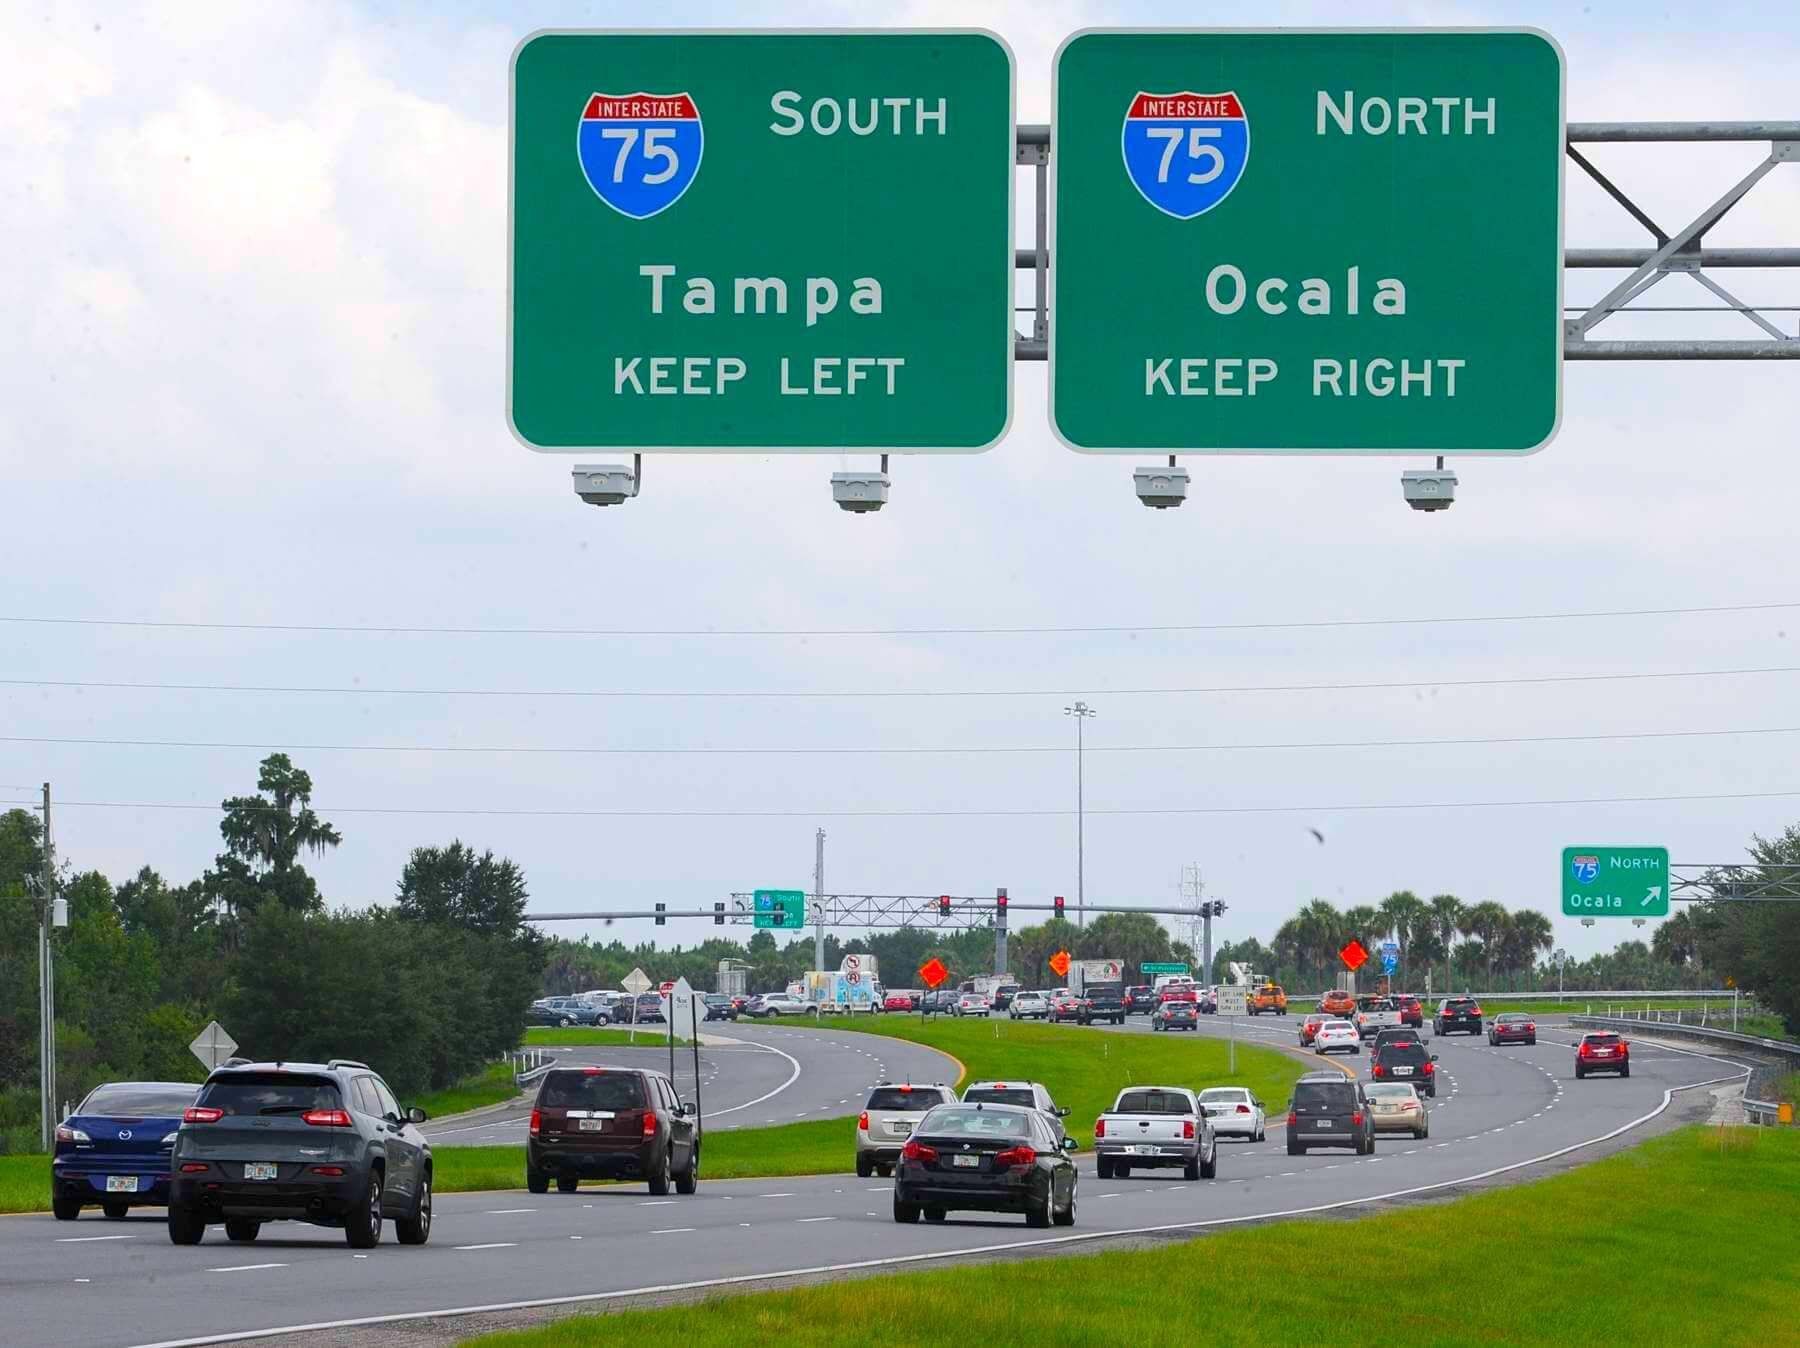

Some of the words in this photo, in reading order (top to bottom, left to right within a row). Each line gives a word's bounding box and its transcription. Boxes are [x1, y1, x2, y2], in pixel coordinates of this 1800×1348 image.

[598, 101, 683, 117] INTERSTATE
[770, 91, 946, 135] SOUTH
[1143, 100, 1230, 116] INTERSTATE
[1317, 91, 1496, 135] NORTH
[602, 128, 679, 184] 75
[1147, 127, 1224, 184] 75
[639, 264, 882, 325] Tampa
[1206, 264, 1406, 316] Ocala
[615, 357, 747, 395] KEEP
[781, 357, 905, 395] LEFT
[1146, 358, 1278, 396] KEEP
[1313, 358, 1466, 397] RIGHT
[1574, 863, 1598, 878] 75
[1610, 855, 1660, 869] NORTH
[1570, 893, 1623, 908] Ocala
[1382, 954, 1398, 966] 75
